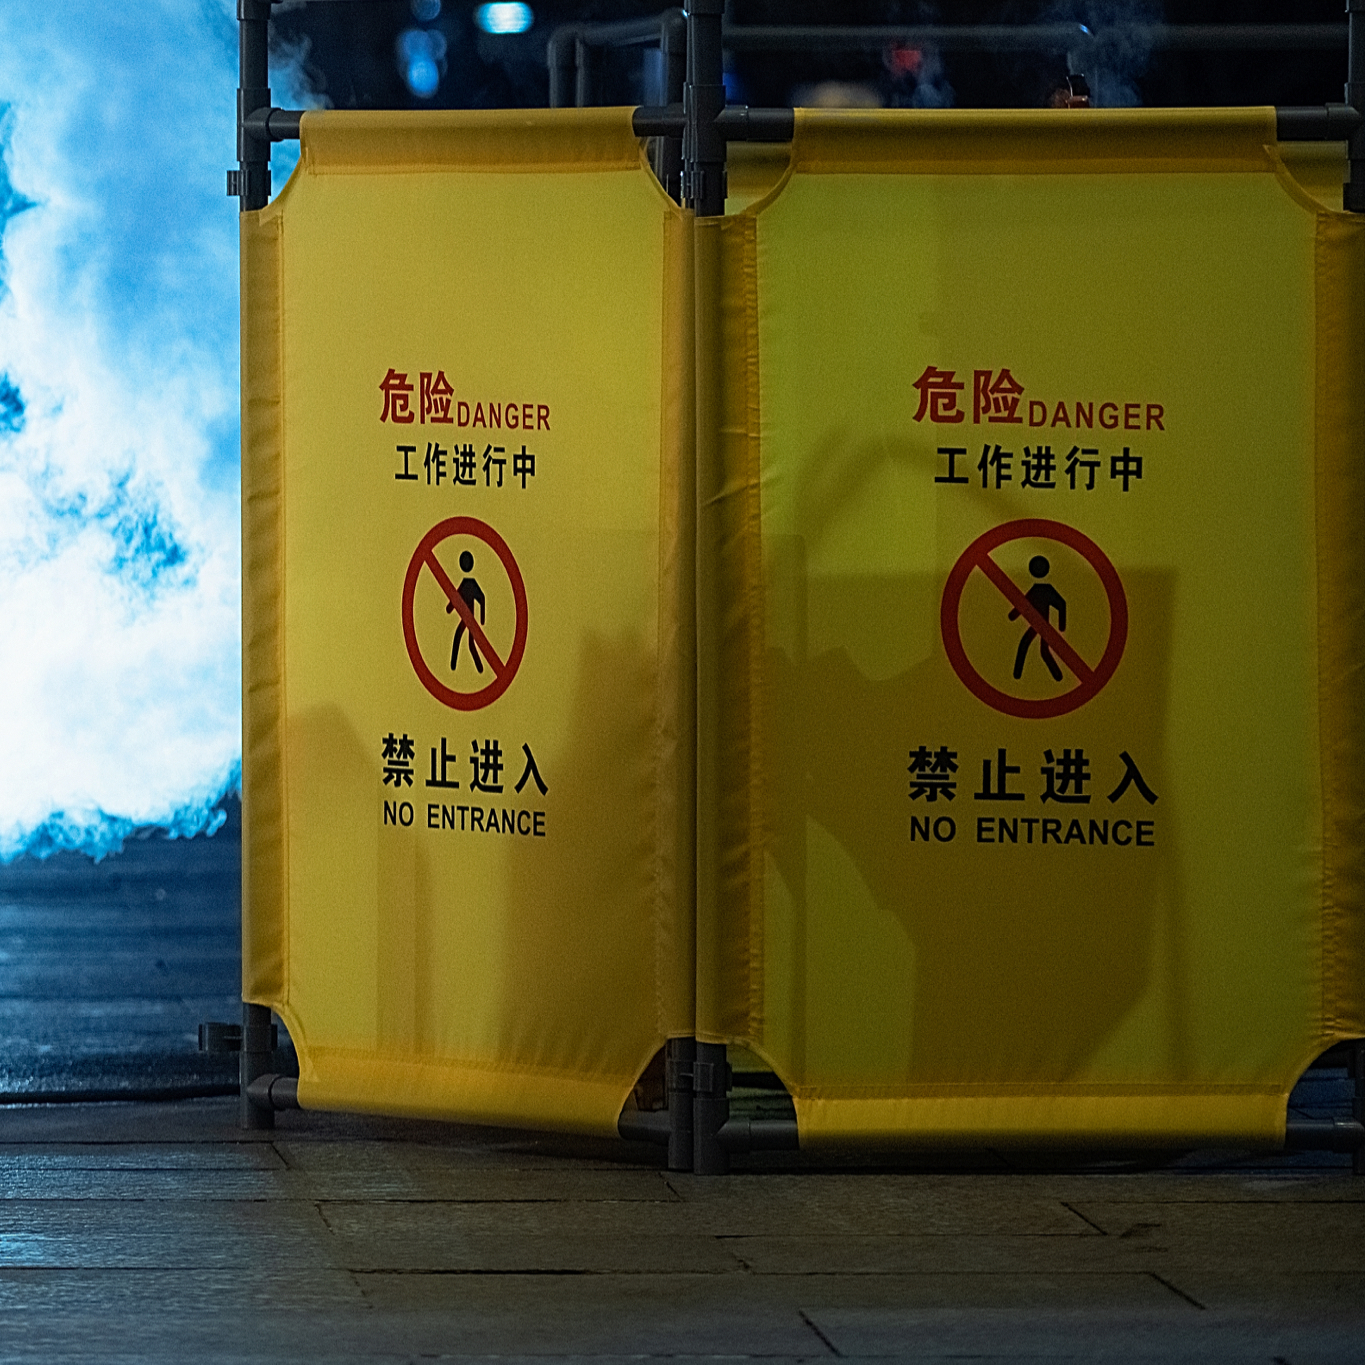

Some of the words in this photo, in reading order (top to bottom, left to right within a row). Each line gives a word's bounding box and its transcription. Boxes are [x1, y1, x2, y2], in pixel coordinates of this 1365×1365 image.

[378, 367, 454, 424] 危险
[456, 400, 550, 430] DANGER
[911, 365, 1024, 424] 危险
[1027, 400, 1164, 431] DANGER
[393, 441, 535, 489] 工作进行中
[932, 443, 1143, 491] 工作进行中
[380, 731, 547, 796] 禁止进入
[906, 743, 1158, 805] 禁止进入
[382, 799, 414, 827] NO
[427, 802, 546, 837] ENTRANCE
[909, 814, 956, 842] NO
[975, 815, 1155, 846] ENTRANCE
